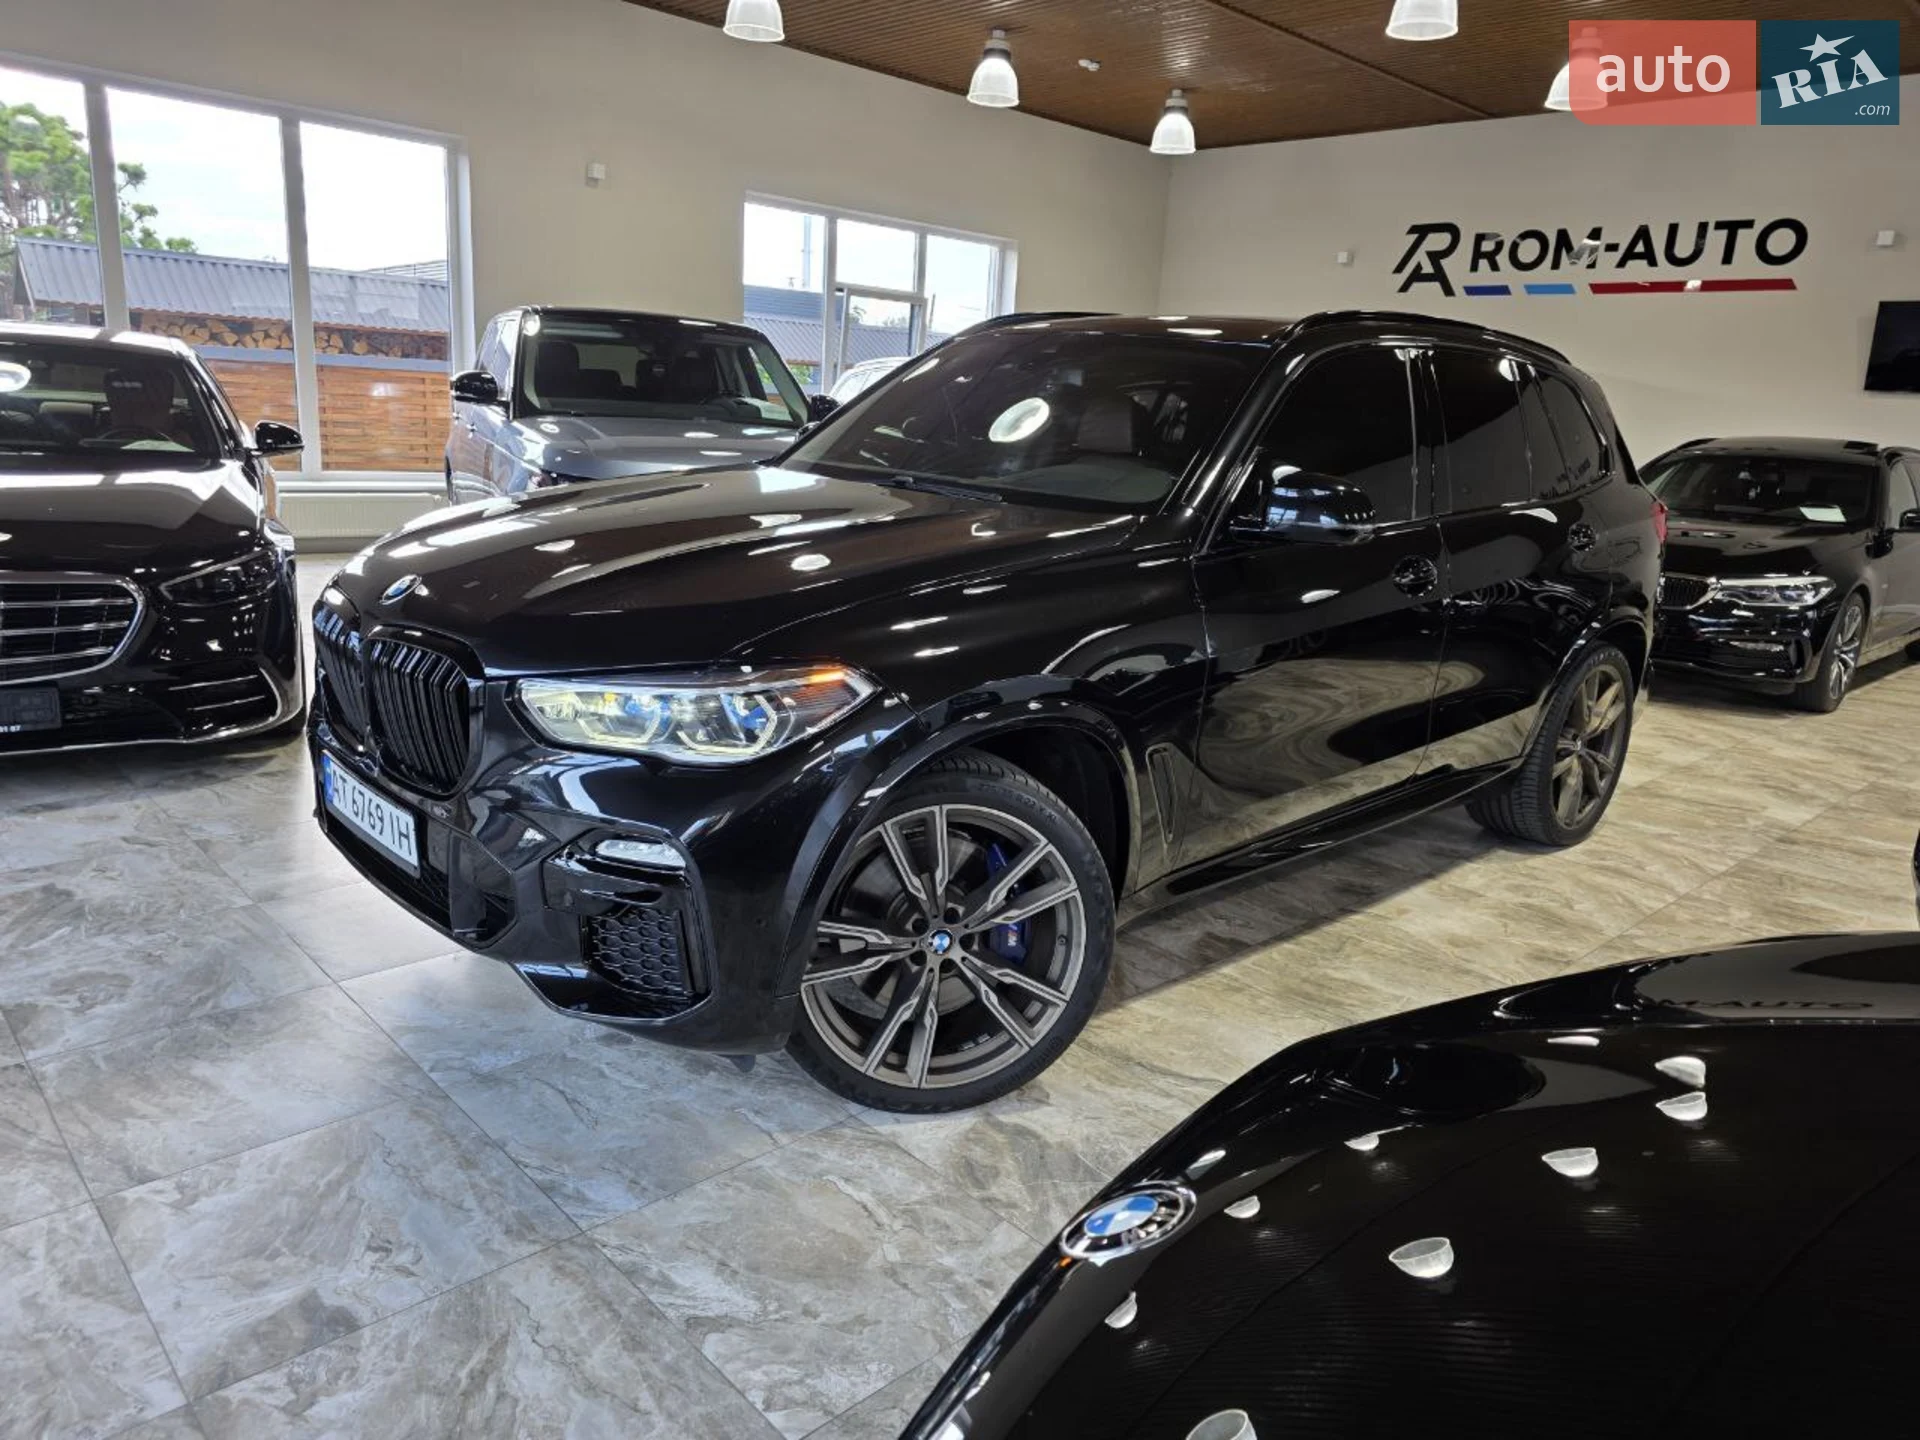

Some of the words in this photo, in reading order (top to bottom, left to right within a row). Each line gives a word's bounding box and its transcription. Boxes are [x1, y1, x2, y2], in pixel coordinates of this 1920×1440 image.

[1469, 217, 1809, 273] ROM-AUTO
[351, 785, 385, 836] 6769
[389, 811, 412, 856] IH
